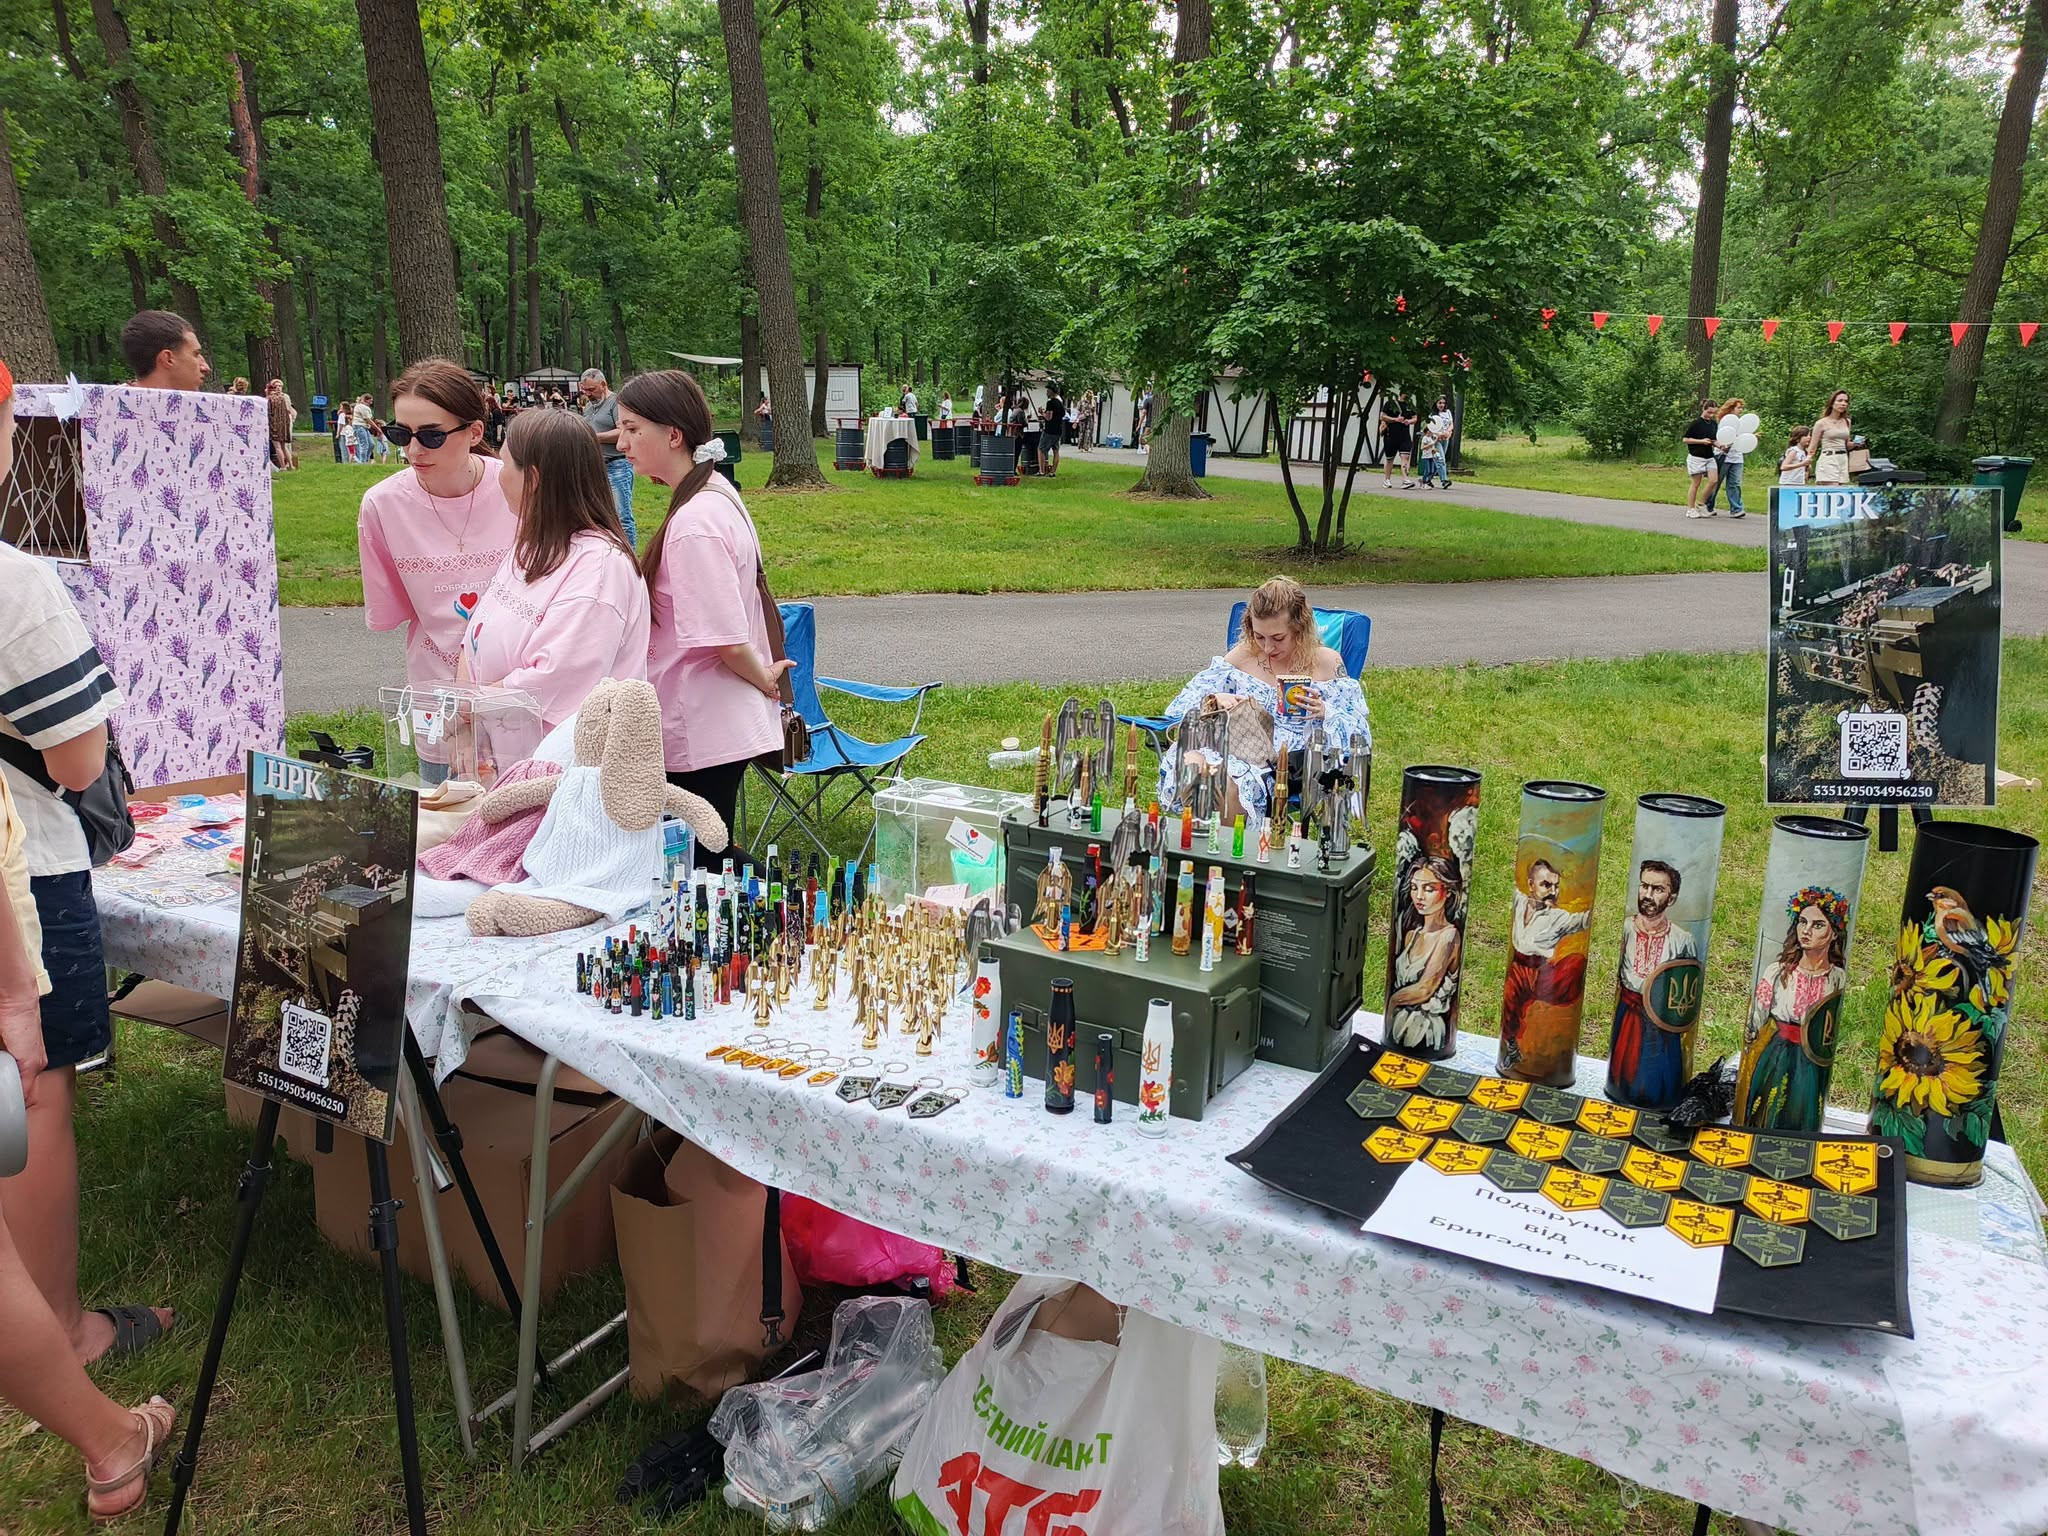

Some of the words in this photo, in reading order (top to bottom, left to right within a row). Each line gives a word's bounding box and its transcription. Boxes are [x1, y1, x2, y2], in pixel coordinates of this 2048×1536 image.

[1813, 784, 1933, 798] 5351295034956250
[257, 1071, 344, 1114] 5351295034956250
[1429, 1216, 1552, 1256] Бригади
[1475, 1188, 1637, 1244] Подарунок
[1523, 1223, 1568, 1245] від
